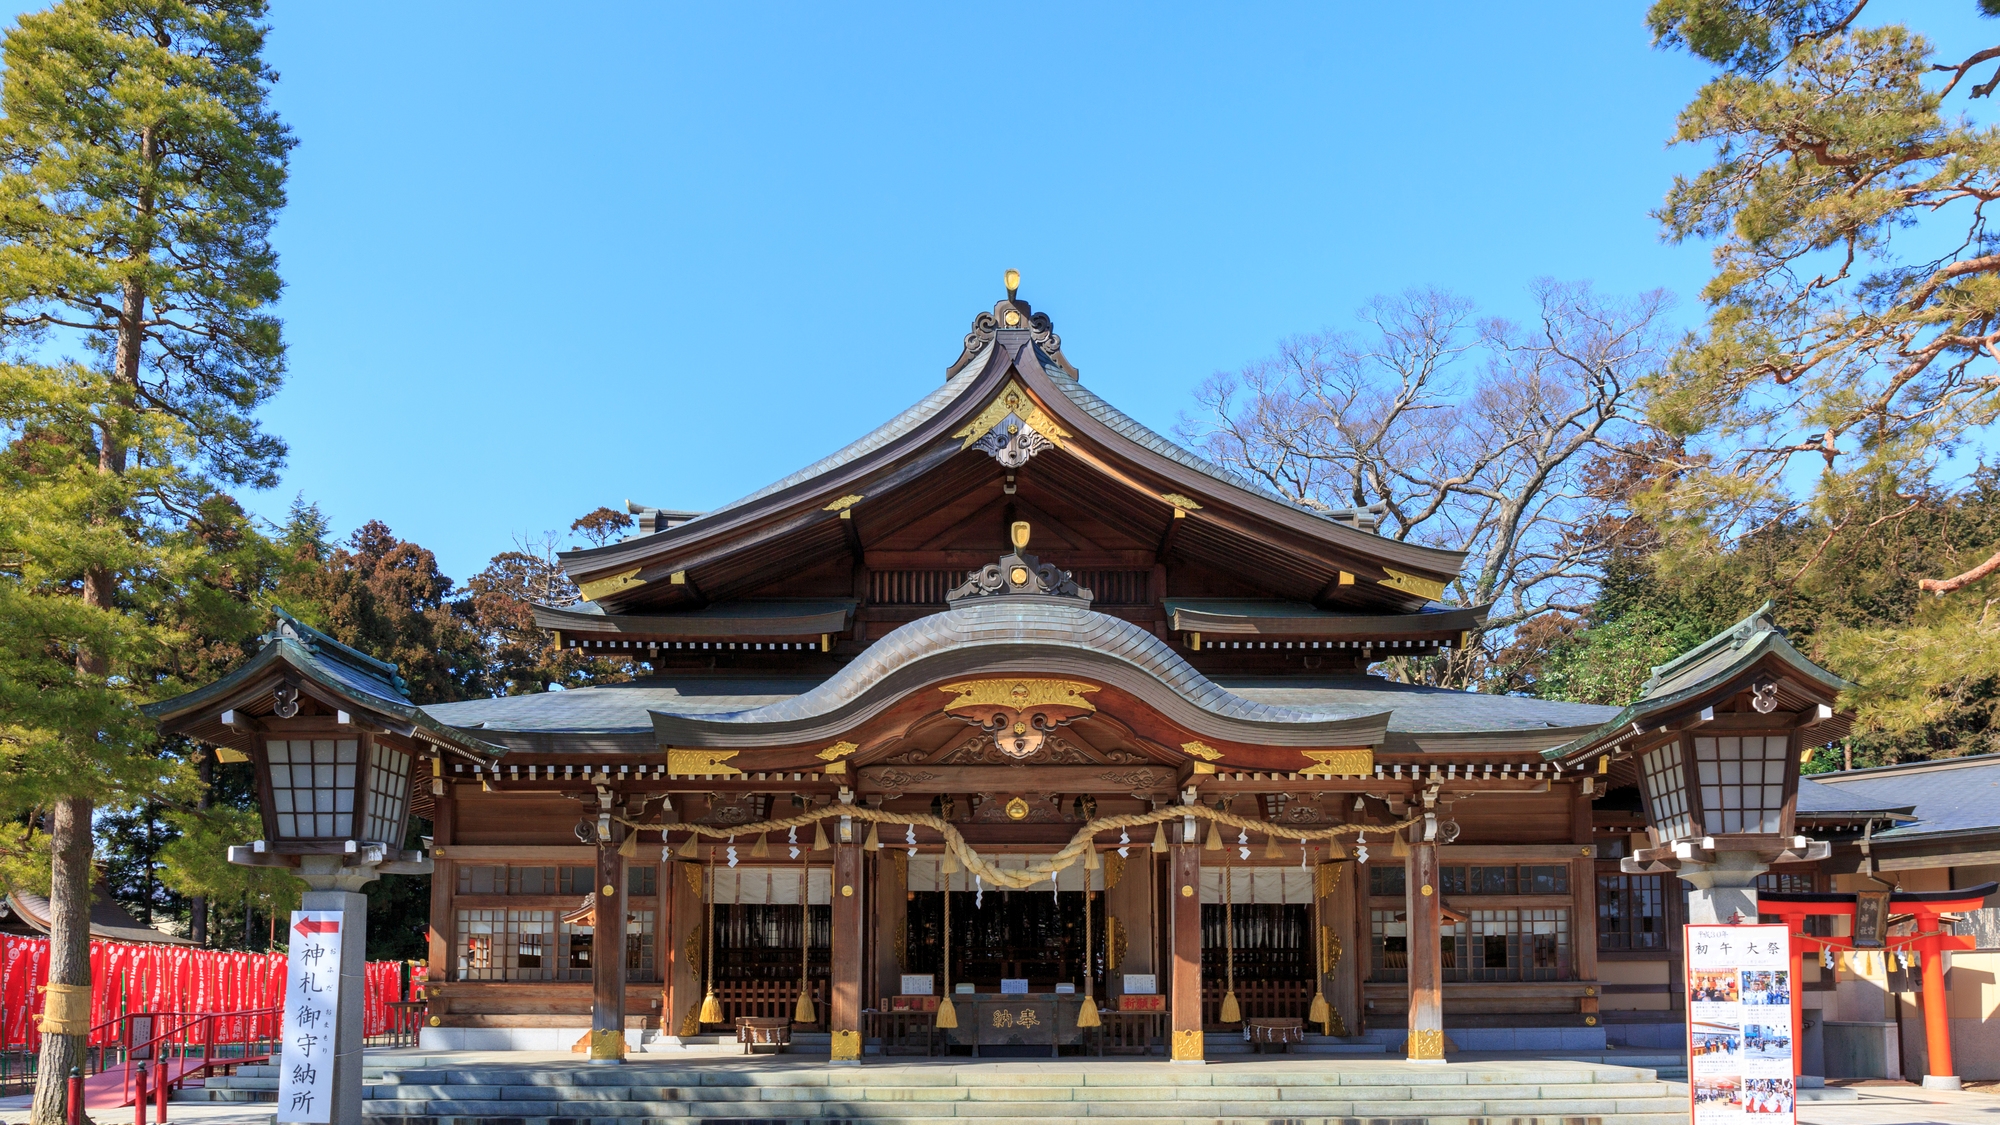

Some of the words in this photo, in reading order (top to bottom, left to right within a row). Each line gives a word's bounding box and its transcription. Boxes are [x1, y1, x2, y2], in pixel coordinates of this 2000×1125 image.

[326, 948, 337, 992] おふだ
[1695, 942, 1780, 956] 初午大祭
[289, 943, 325, 1115] 神札・御守納所
[322, 1009, 332, 1054] おまもり
